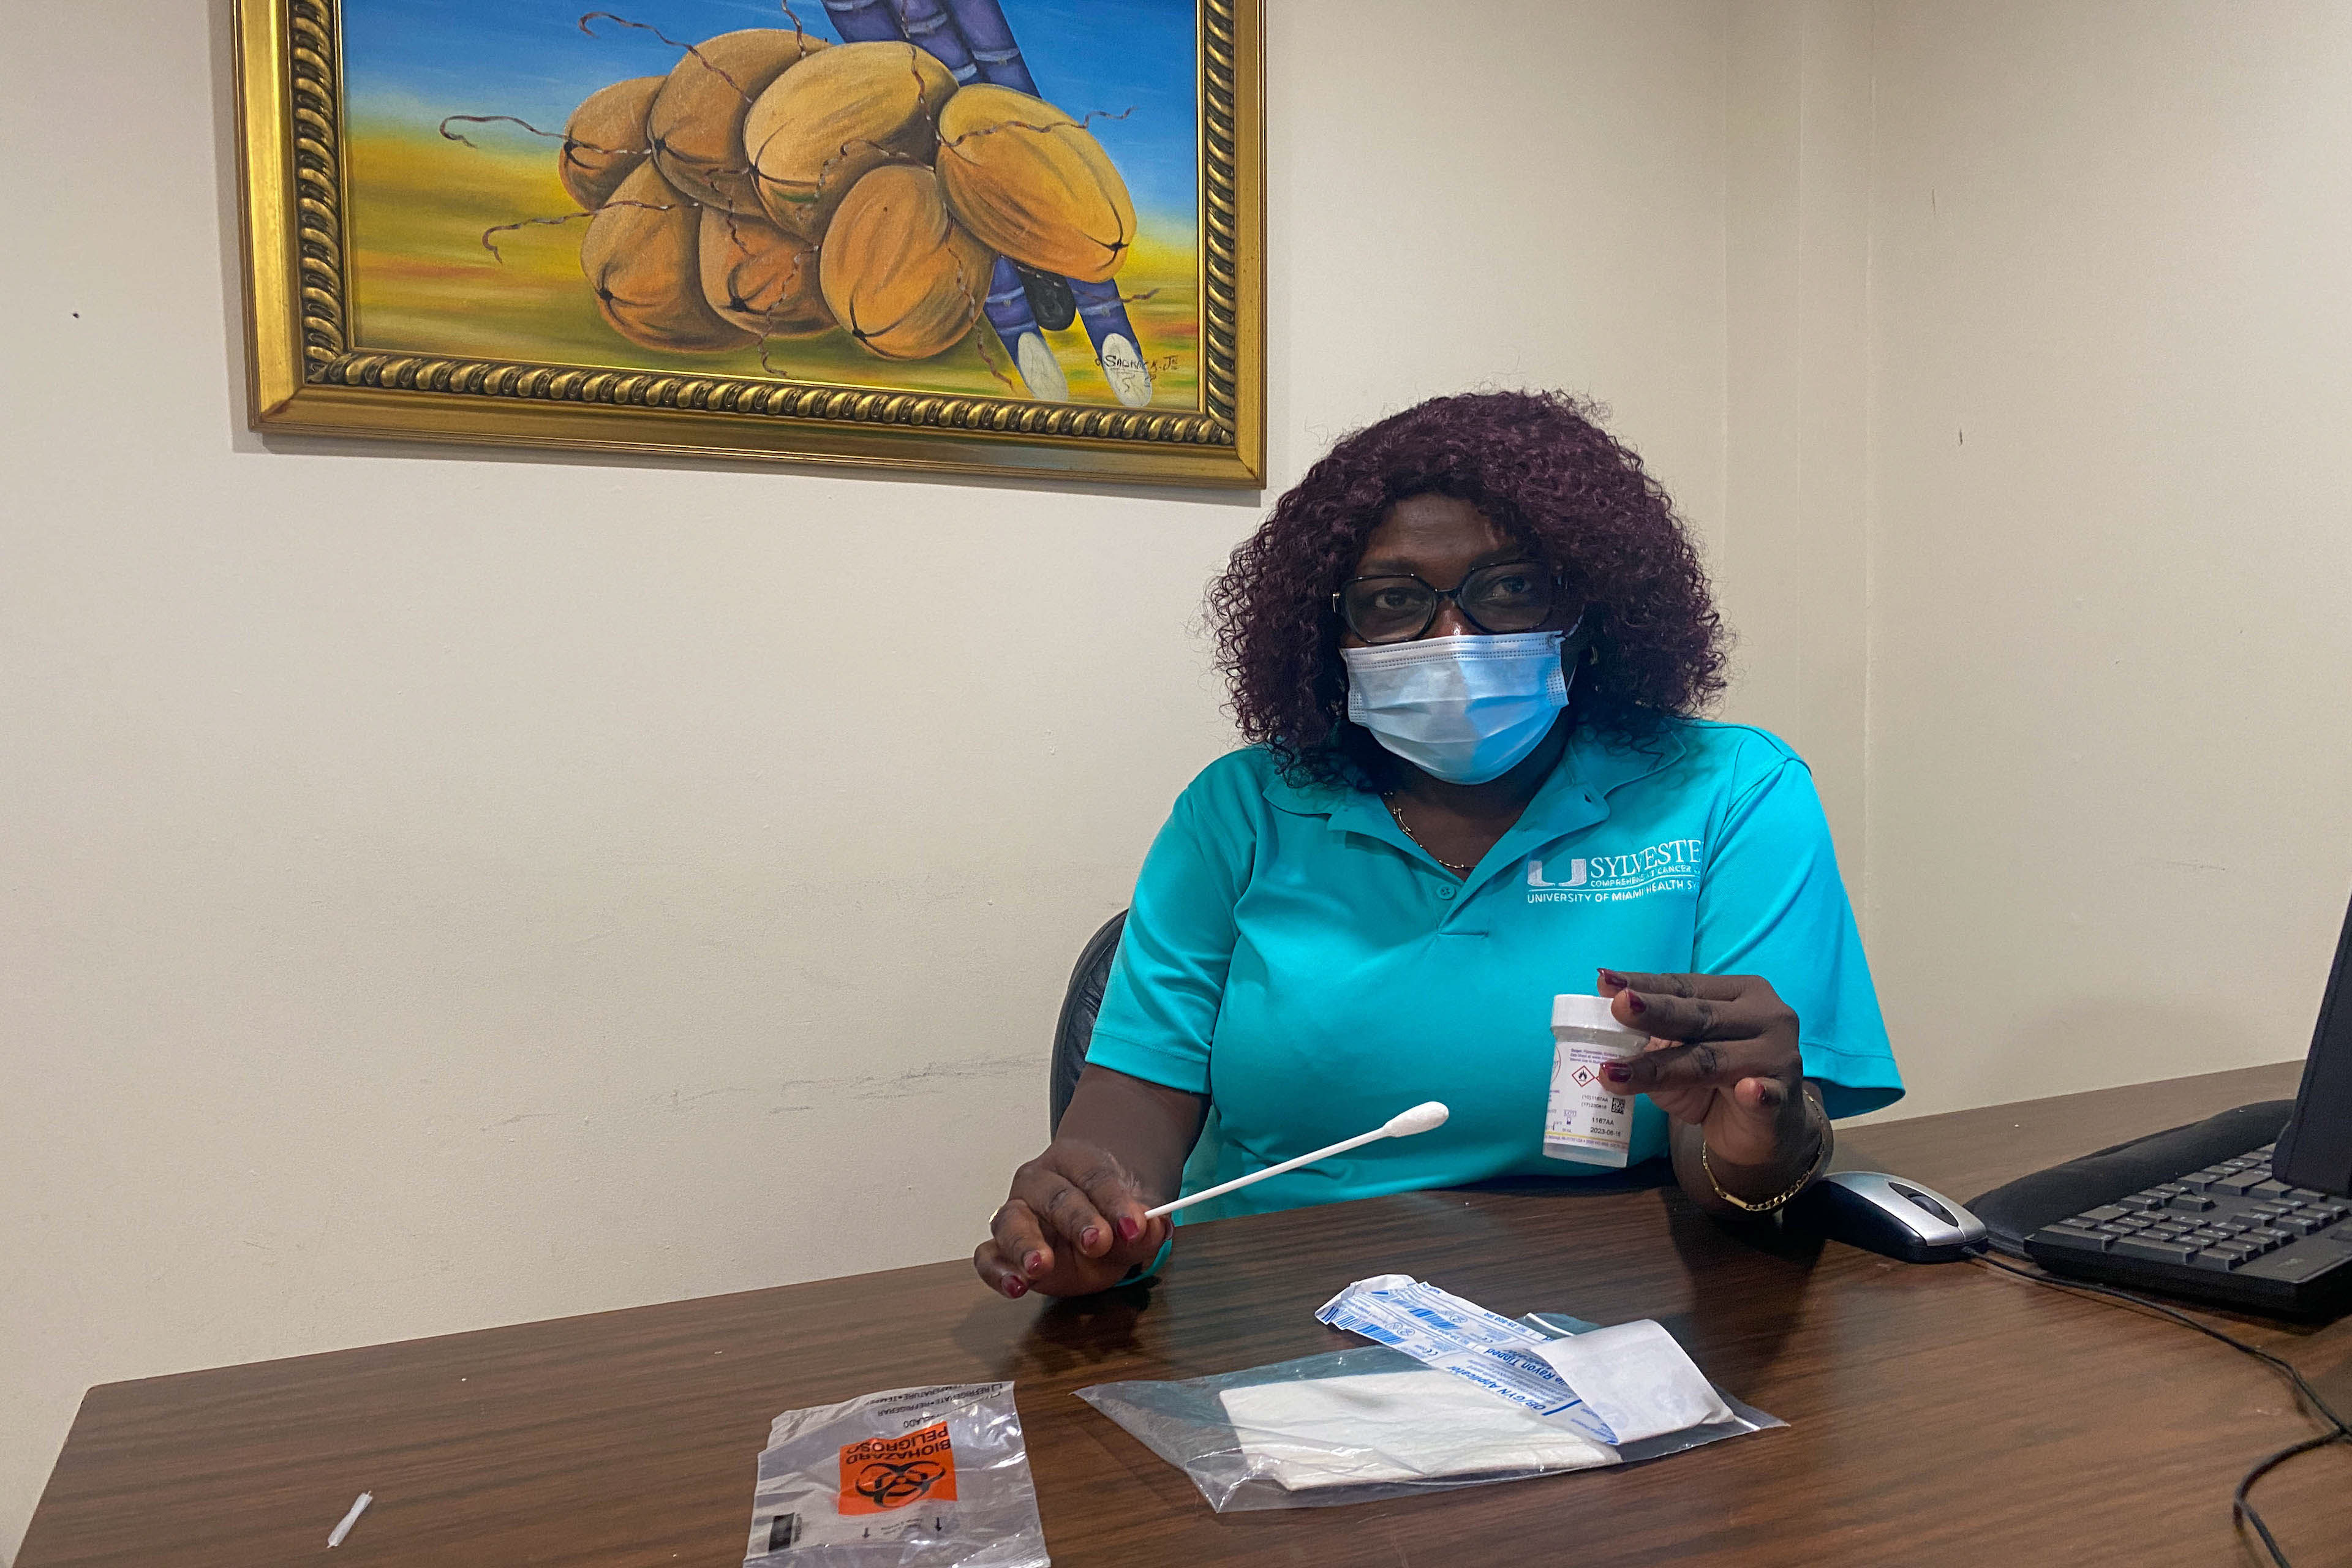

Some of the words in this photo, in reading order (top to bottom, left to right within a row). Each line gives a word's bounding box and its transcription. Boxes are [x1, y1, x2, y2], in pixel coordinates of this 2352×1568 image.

[1591, 839, 1702, 878] SYLVESTE
[1527, 893, 1591, 903] UNIVERSITY
[1595, 892, 1609, 902] OF
[1611, 889, 1644, 901] MIAMI
[1521, 1362, 1556, 1380] Rayon
[846, 1439, 951, 1464] BIOHAZARD
